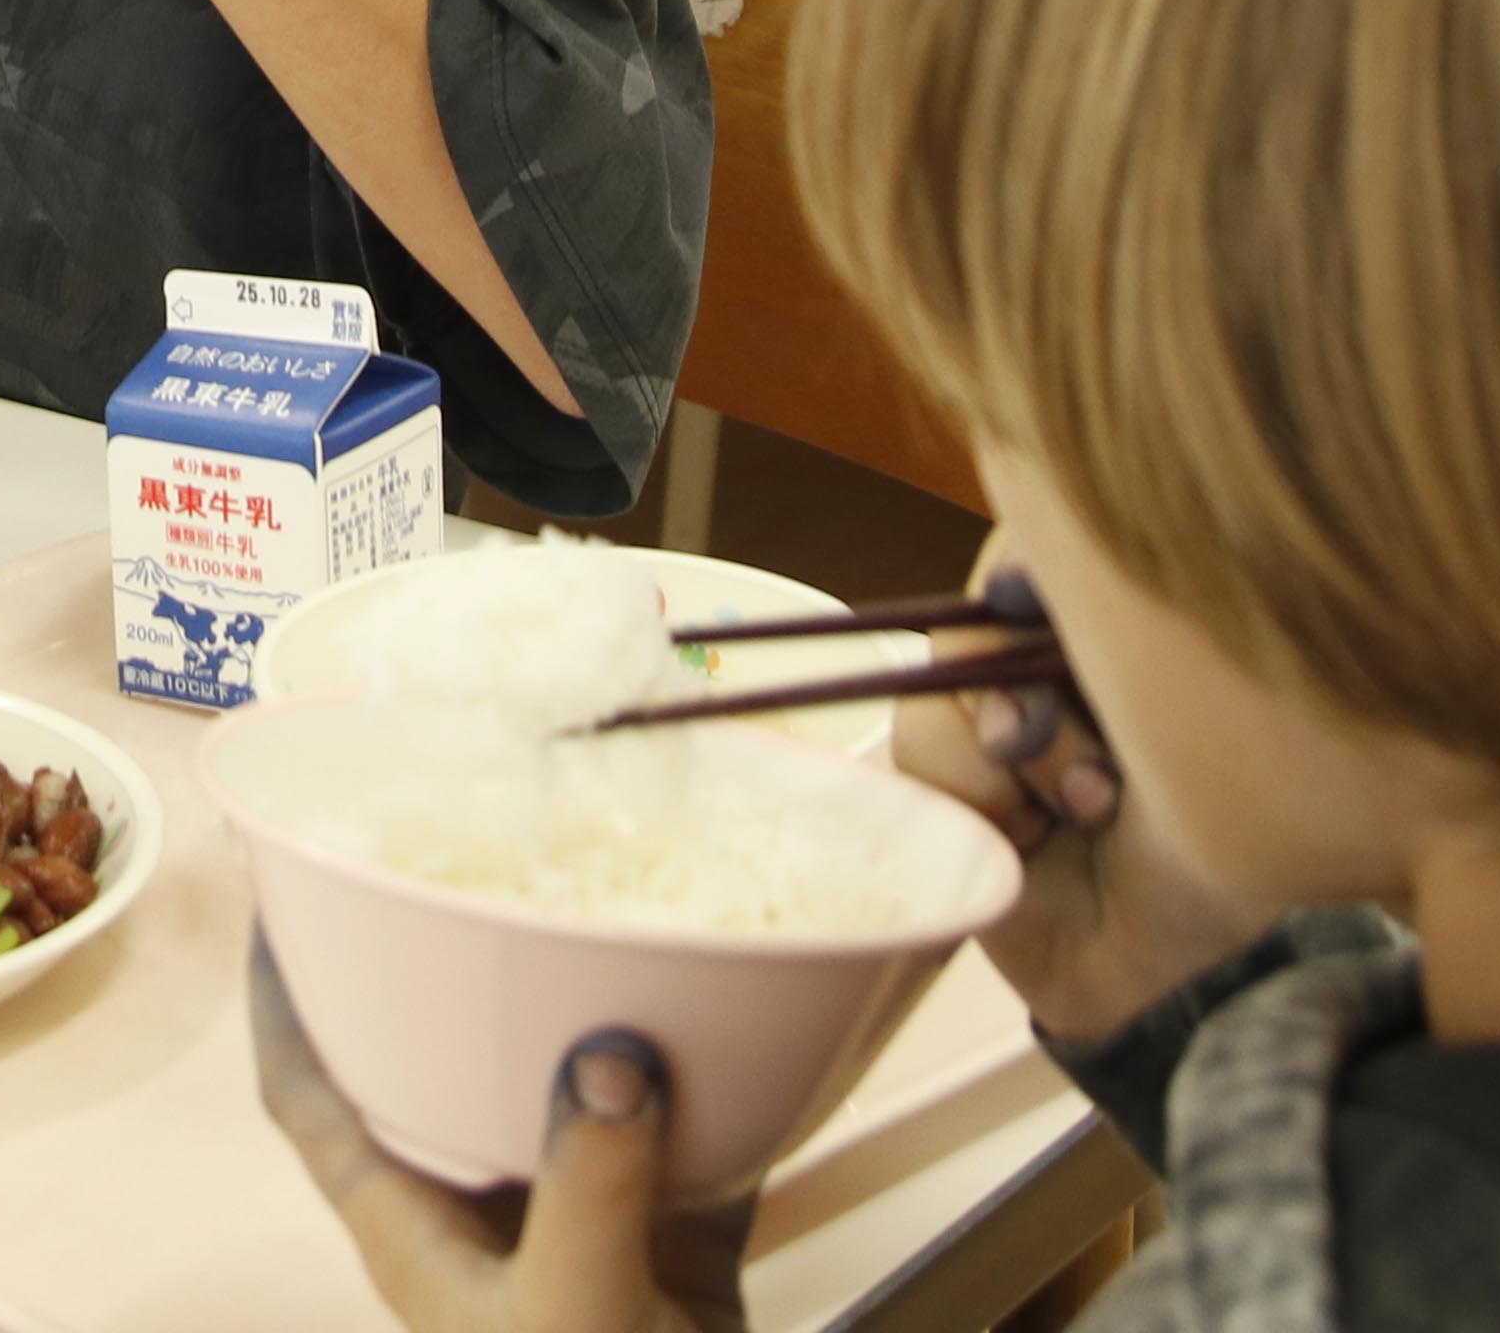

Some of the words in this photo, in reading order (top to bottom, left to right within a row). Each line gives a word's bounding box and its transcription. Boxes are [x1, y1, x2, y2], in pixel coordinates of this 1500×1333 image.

[236, 280, 322, 310] 25.10.28
[166, 342, 337, 381] 自然のおいしさ
[151, 375, 293, 418] 黒東牛乳
[172, 456, 242, 482] 成分無調整
[138, 476, 283, 531] 黒東牛乳
[125, 622, 174, 647] 200ml
